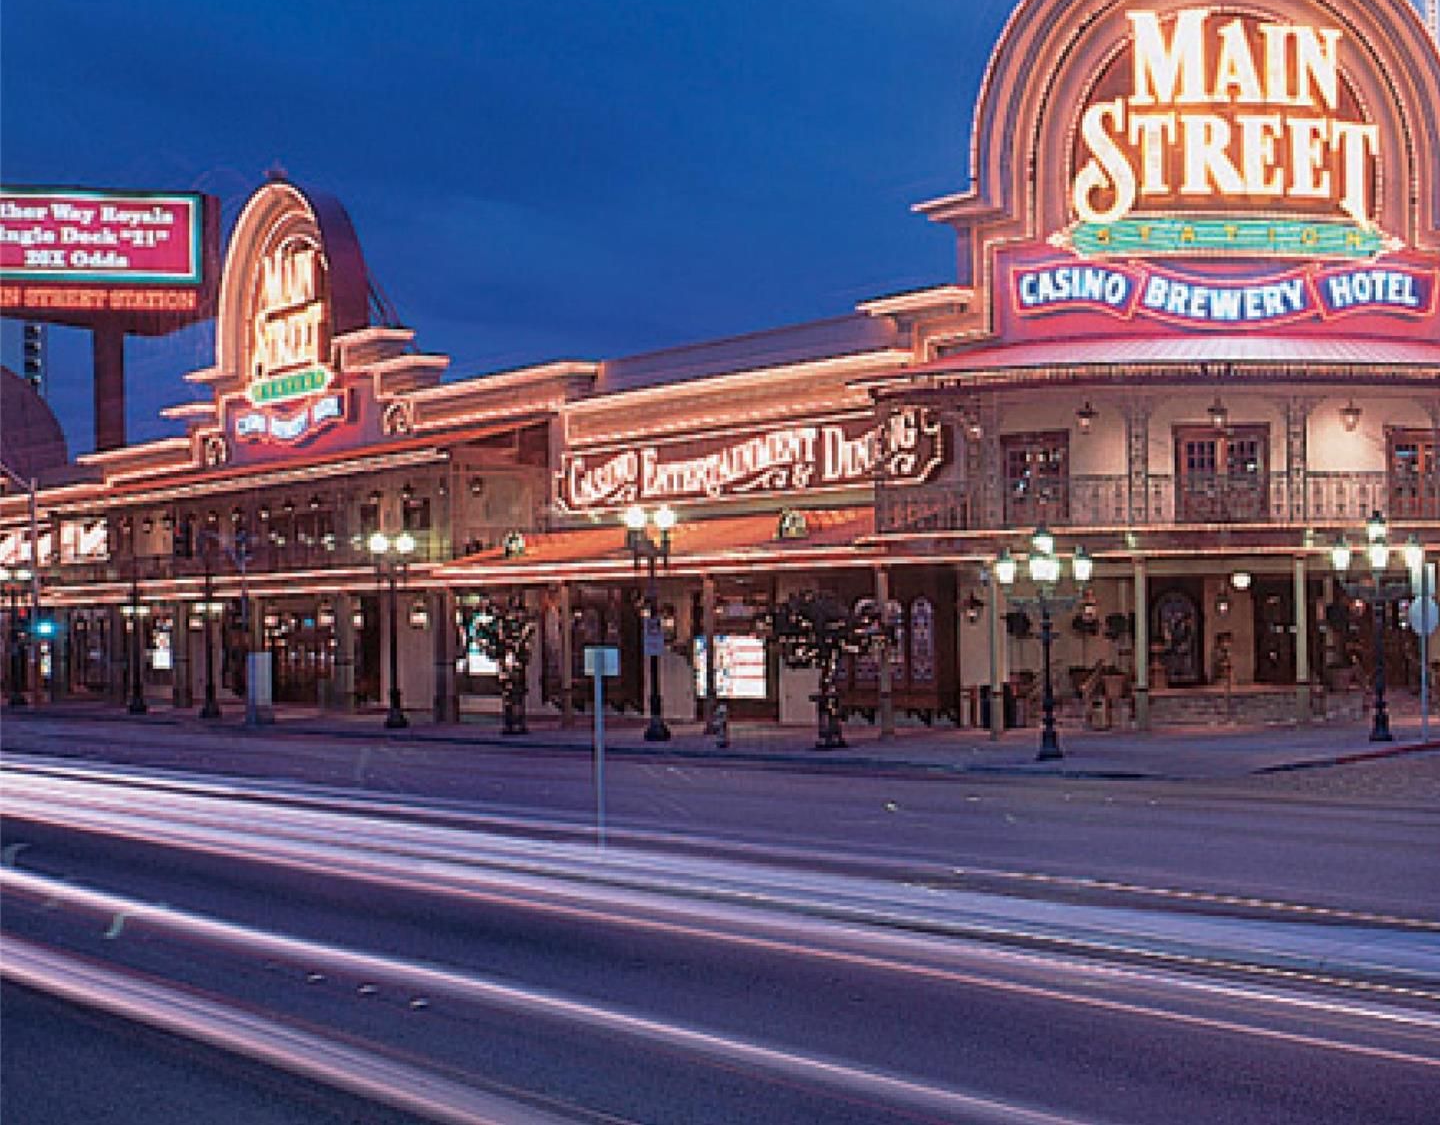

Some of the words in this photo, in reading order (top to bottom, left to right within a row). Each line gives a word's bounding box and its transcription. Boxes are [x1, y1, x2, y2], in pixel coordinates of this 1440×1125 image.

[1125, 9, 1343, 110] MAIN
[1073, 100, 1379, 229] STREET
[51, 204, 96, 225] Way
[1097, 224, 1362, 247] STATION
[70, 251, 129, 268] Odds
[25, 287, 108, 308] STREET
[109, 289, 197, 311] STATION
[1020, 267, 1127, 306] CASINO
[1143, 276, 1305, 320] BREWERY
[1329, 270, 1420, 307] HOTEL
[569, 450, 638, 505] CASINO
[641, 427, 818, 497] ENTERTAINMENT
